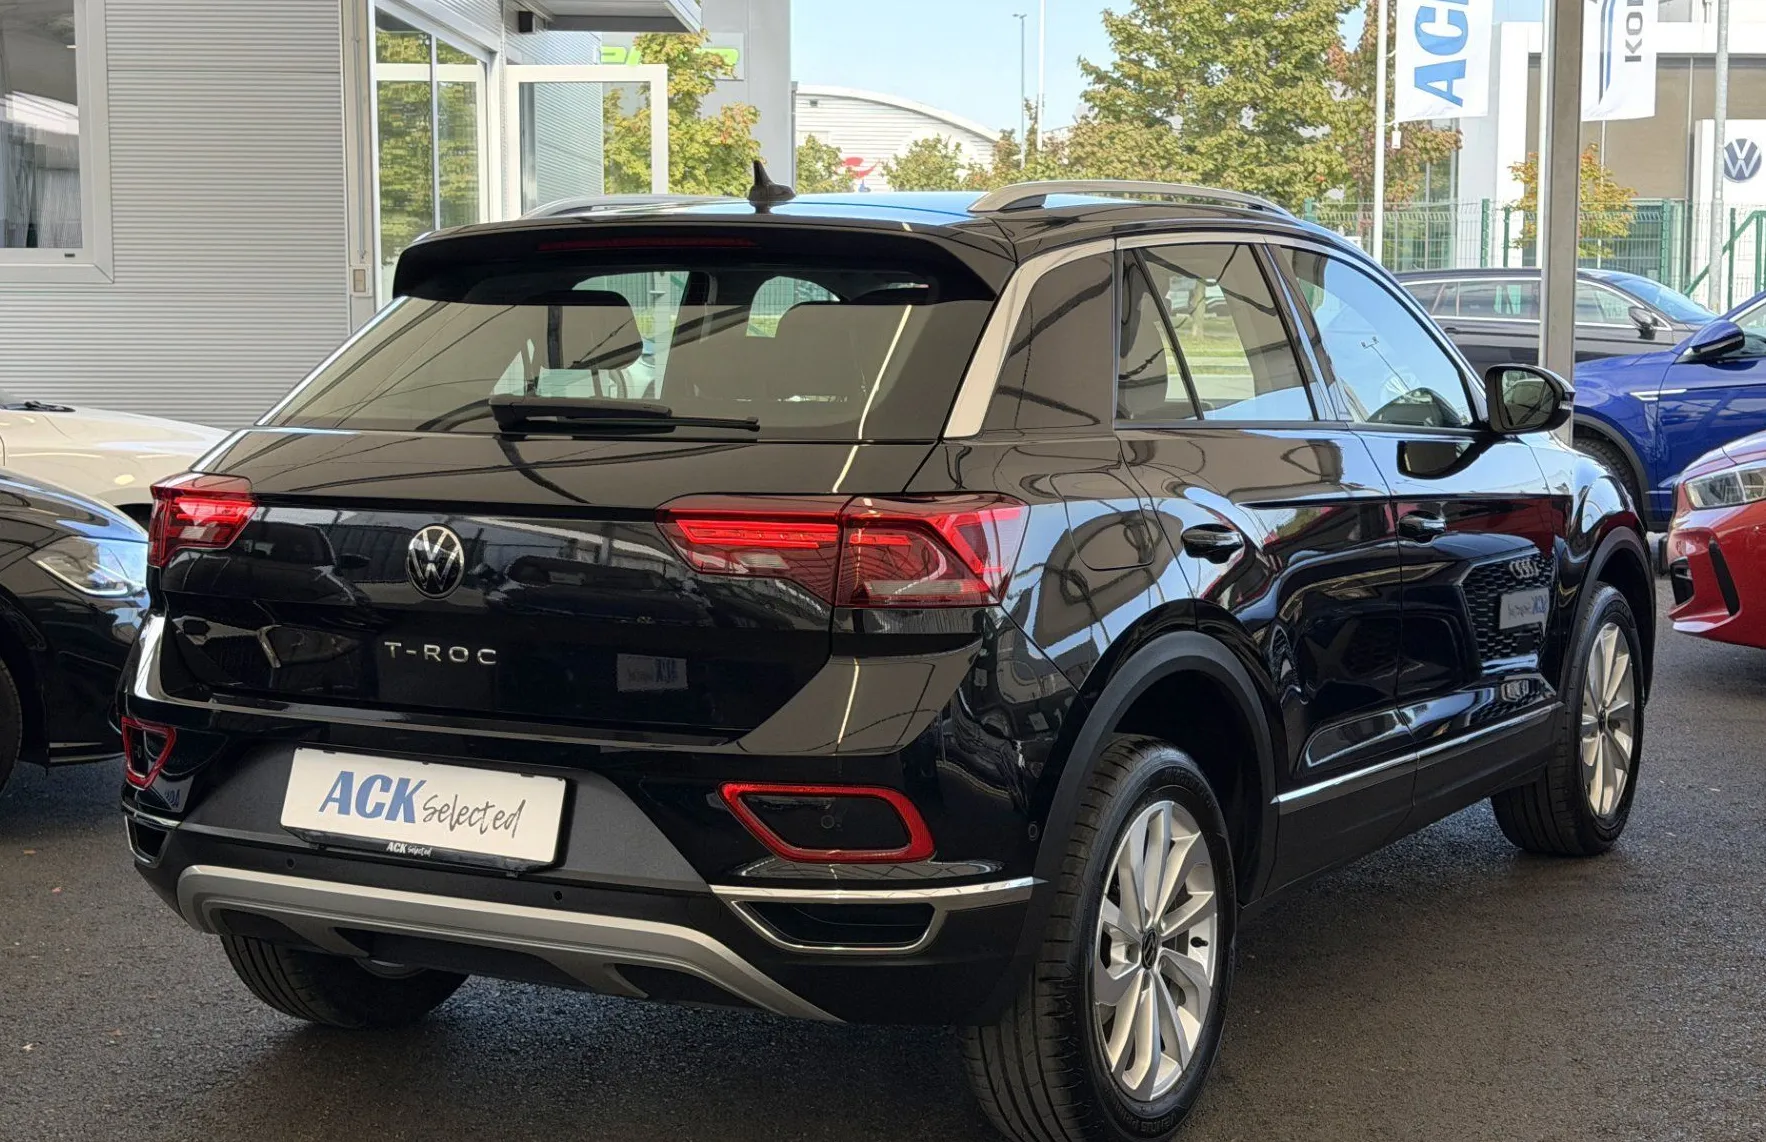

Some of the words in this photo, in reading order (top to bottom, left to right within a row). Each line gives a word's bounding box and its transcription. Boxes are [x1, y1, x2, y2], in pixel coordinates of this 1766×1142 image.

[1414, 0, 1469, 107] AC
[1625, 0, 1644, 62] KO
[384, 641, 497, 665] T-ROC
[318, 770, 428, 824] ACK
[422, 794, 527, 839] Selected
[386, 841, 408, 854] ACK
